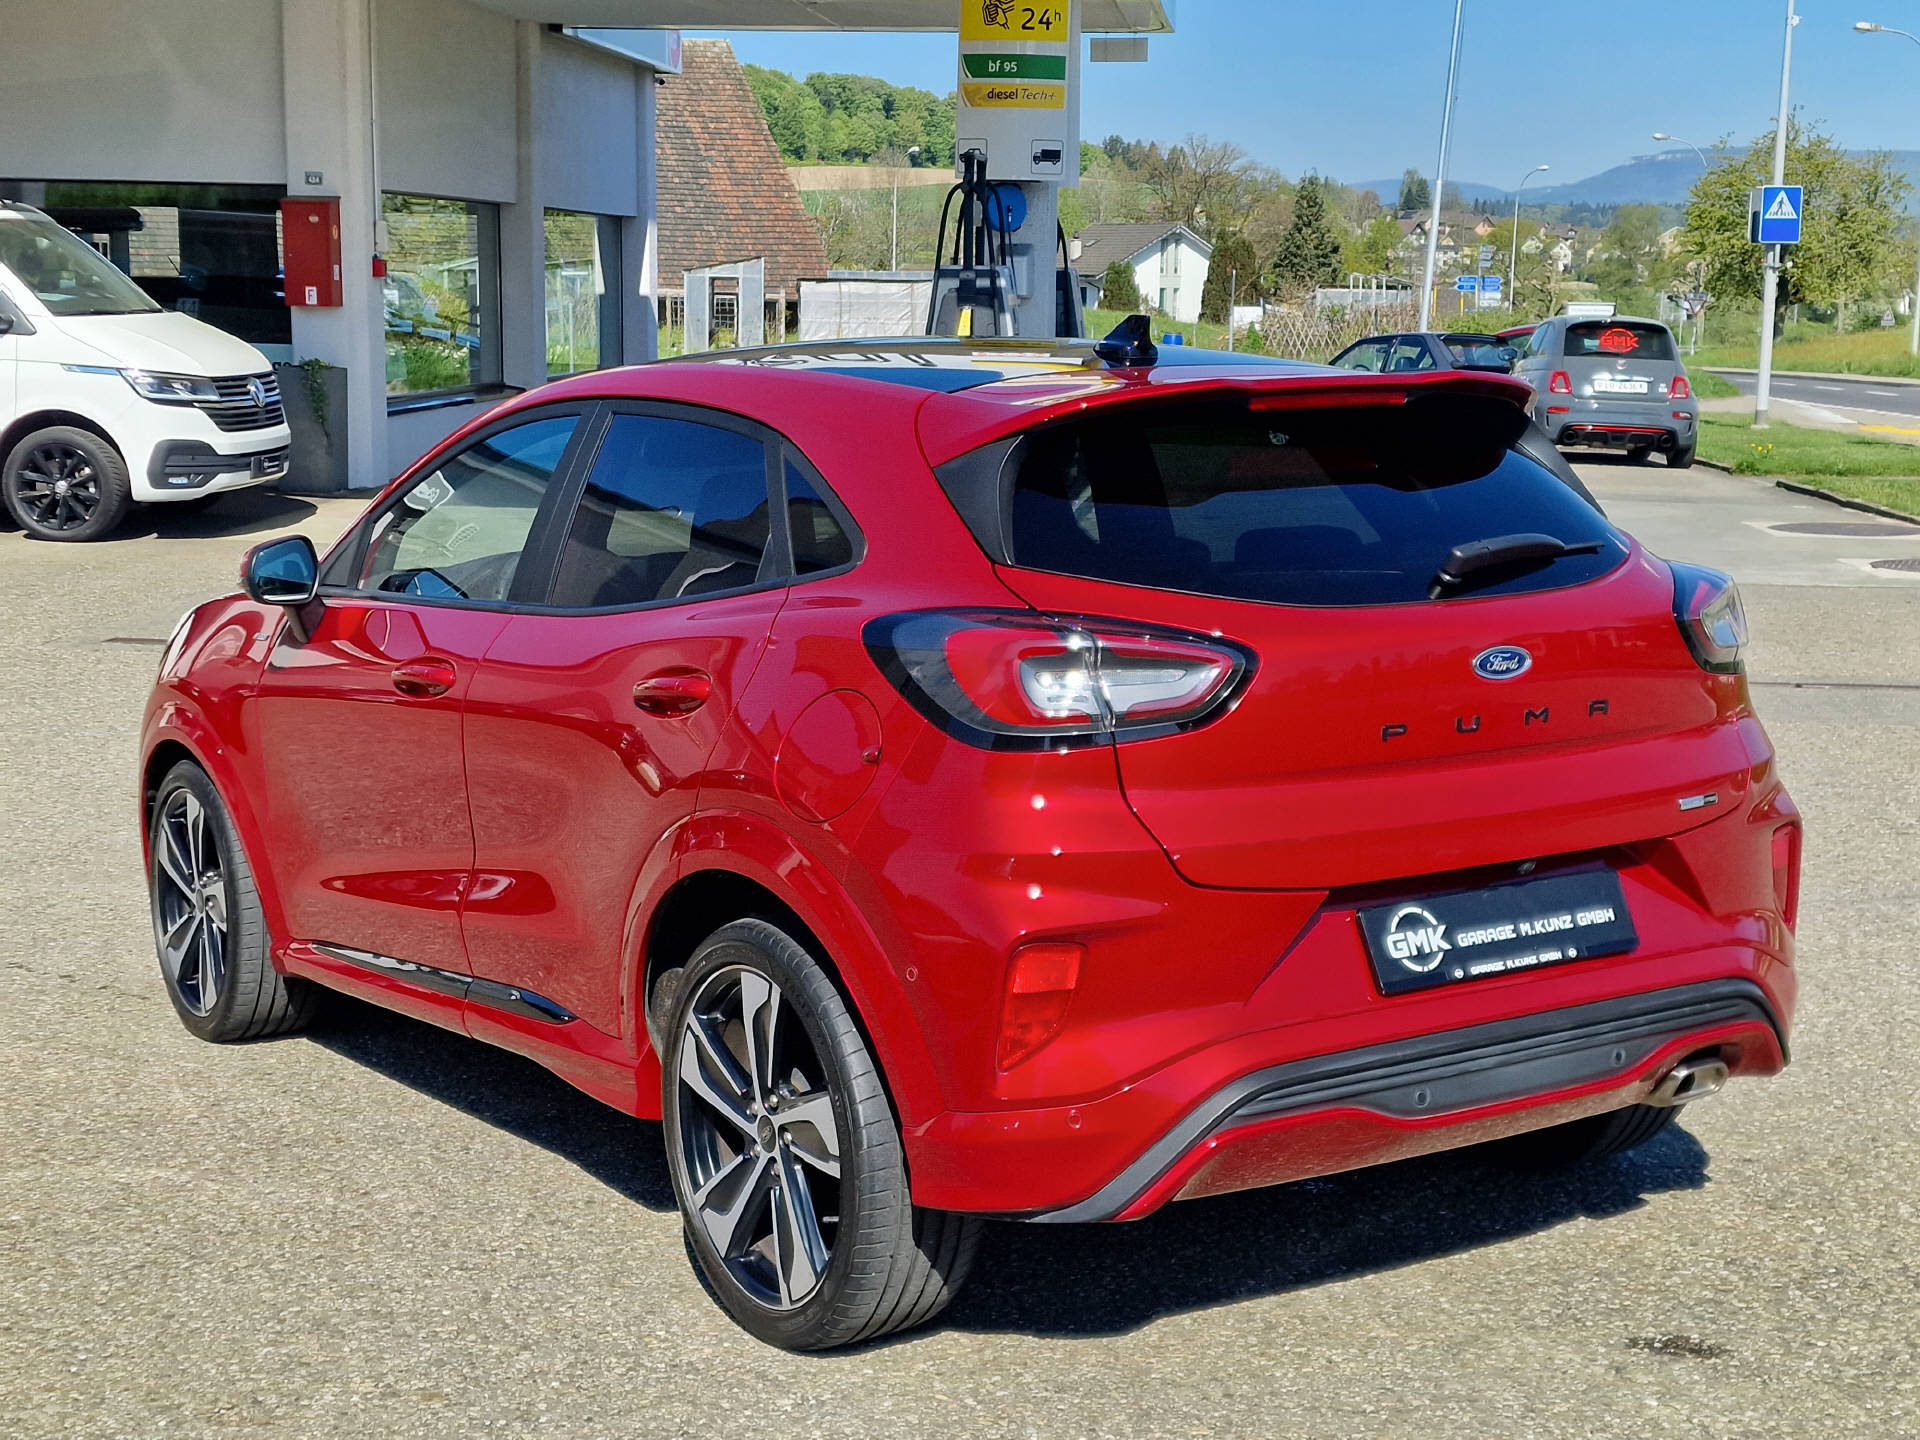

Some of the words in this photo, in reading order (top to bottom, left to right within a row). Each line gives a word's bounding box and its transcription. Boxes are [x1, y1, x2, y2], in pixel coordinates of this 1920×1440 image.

[988, 60, 1002, 73] bf
[1004, 61, 1018, 72] 95
[987, 87, 1018, 100] diesel
[307, 289, 315, 303] F
[1601, 335, 1639, 348] GMK
[1486, 653, 1520, 671] Ford
[1381, 699, 1609, 742] PUMA
[1457, 924, 1517, 947] GARAGE
[1520, 914, 1574, 936] M.KUNZ
[1577, 908, 1615, 926] GMBH
[1387, 924, 1452, 959] GMK
[1470, 961, 1505, 975] GARAGE
[1507, 955, 1538, 970] M.KUNZ
[1540, 950, 1563, 963] GMBH
